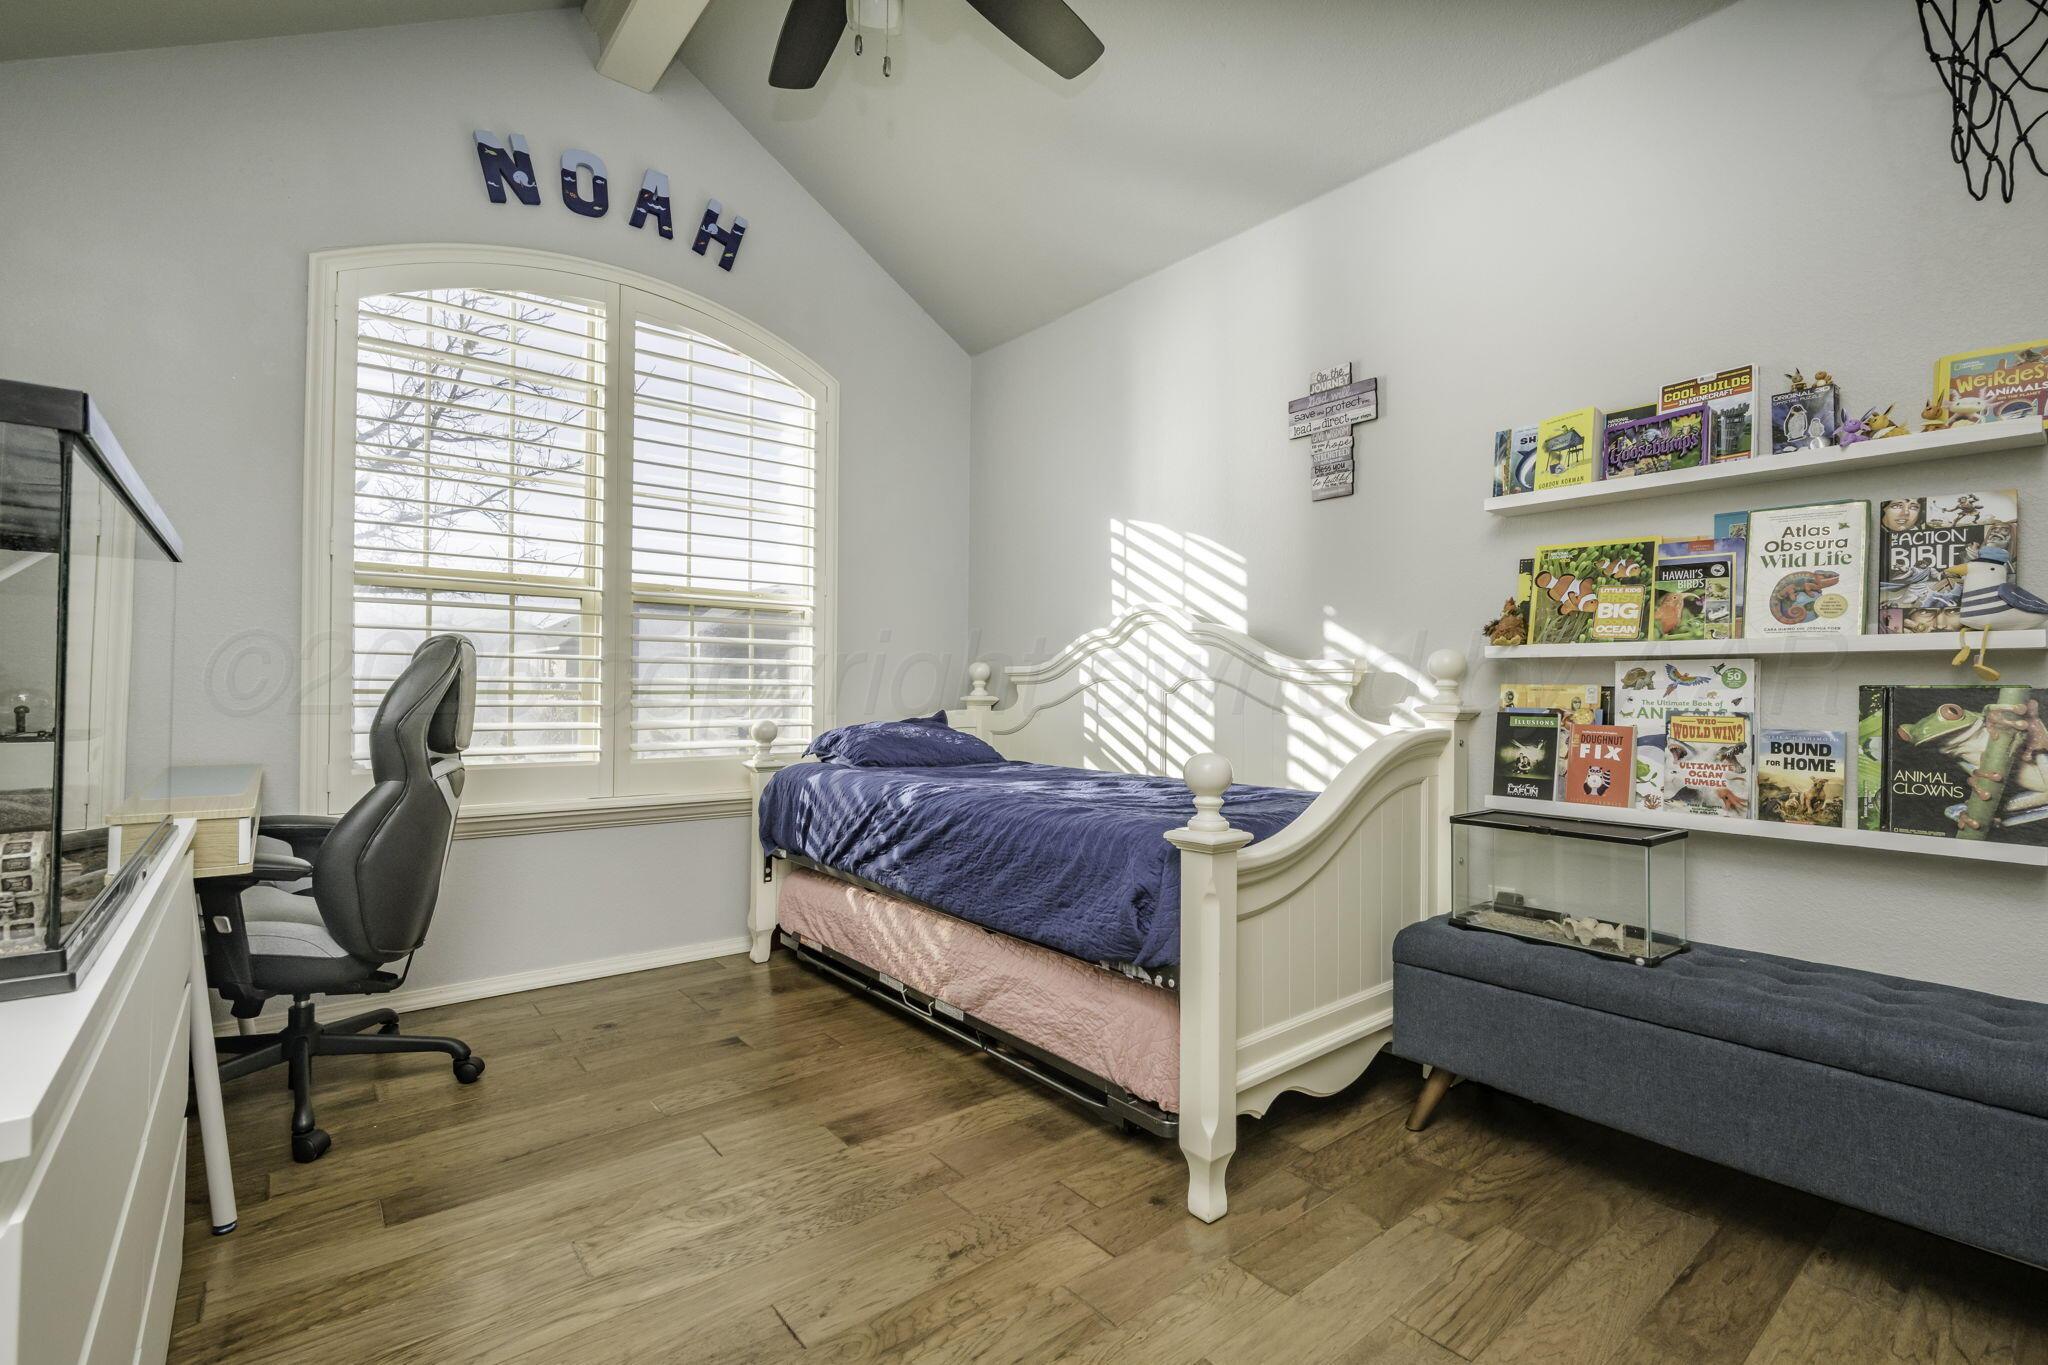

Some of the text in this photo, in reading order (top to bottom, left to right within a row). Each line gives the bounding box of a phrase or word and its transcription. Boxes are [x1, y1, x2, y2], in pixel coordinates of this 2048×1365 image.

[473, 129, 748, 272] NOAH
[1330, 367, 1346, 378] the
[1310, 375, 1350, 395] JOURNEY
[1663, 375, 1750, 403] COOL BUILDS
[1688, 388, 1734, 404] MINECRAFT
[1773, 389, 1814, 402] ORIGINAL
[1294, 410, 1316, 422] save
[1325, 396, 1362, 417] protect
[1293, 422, 1312, 437] lead
[1325, 438, 1352, 450] hope
[1608, 432, 1700, 468] Goosebumps
[1314, 465, 1331, 474] bless
[1332, 462, 1346, 471] you
[1538, 480, 1559, 489] GORDON
[1561, 476, 1585, 485] KORMAN
[1781, 524, 1831, 538] Atlas
[1899, 529, 1967, 546] ACTION
[1764, 538, 1849, 553] Obscura
[1891, 532, 1899, 546] THE
[1760, 550, 1853, 568] Wild Life
[1662, 569, 1704, 581] HAWAII'S
[1677, 578, 1705, 589] BIRDS
[1598, 602, 1640, 619] BIG
[1595, 625, 1637, 634] OCEAN
[1727, 672, 1742, 681] 50
[1656, 699, 1690, 707] Ultimate
[1692, 699, 1712, 707] Book
[1714, 700, 1724, 708] of
[1514, 718, 1555, 726] ILLUSIONS
[1672, 722, 1743, 742] WOULD WIN?
[1580, 734, 1624, 746] DOUGHNUT
[1580, 743, 1623, 761] FIX
[1770, 741, 1832, 757] BOUND
[1679, 761, 1735, 772] ULTIMATE
[1765, 757, 1836, 773] FOR HOME
[1688, 770, 1724, 779] OCEAN
[1894, 769, 1954, 785] ANIMAL
[1684, 778, 1728, 788] RUMBLE
[1892, 782, 1964, 799] CLOWNS
